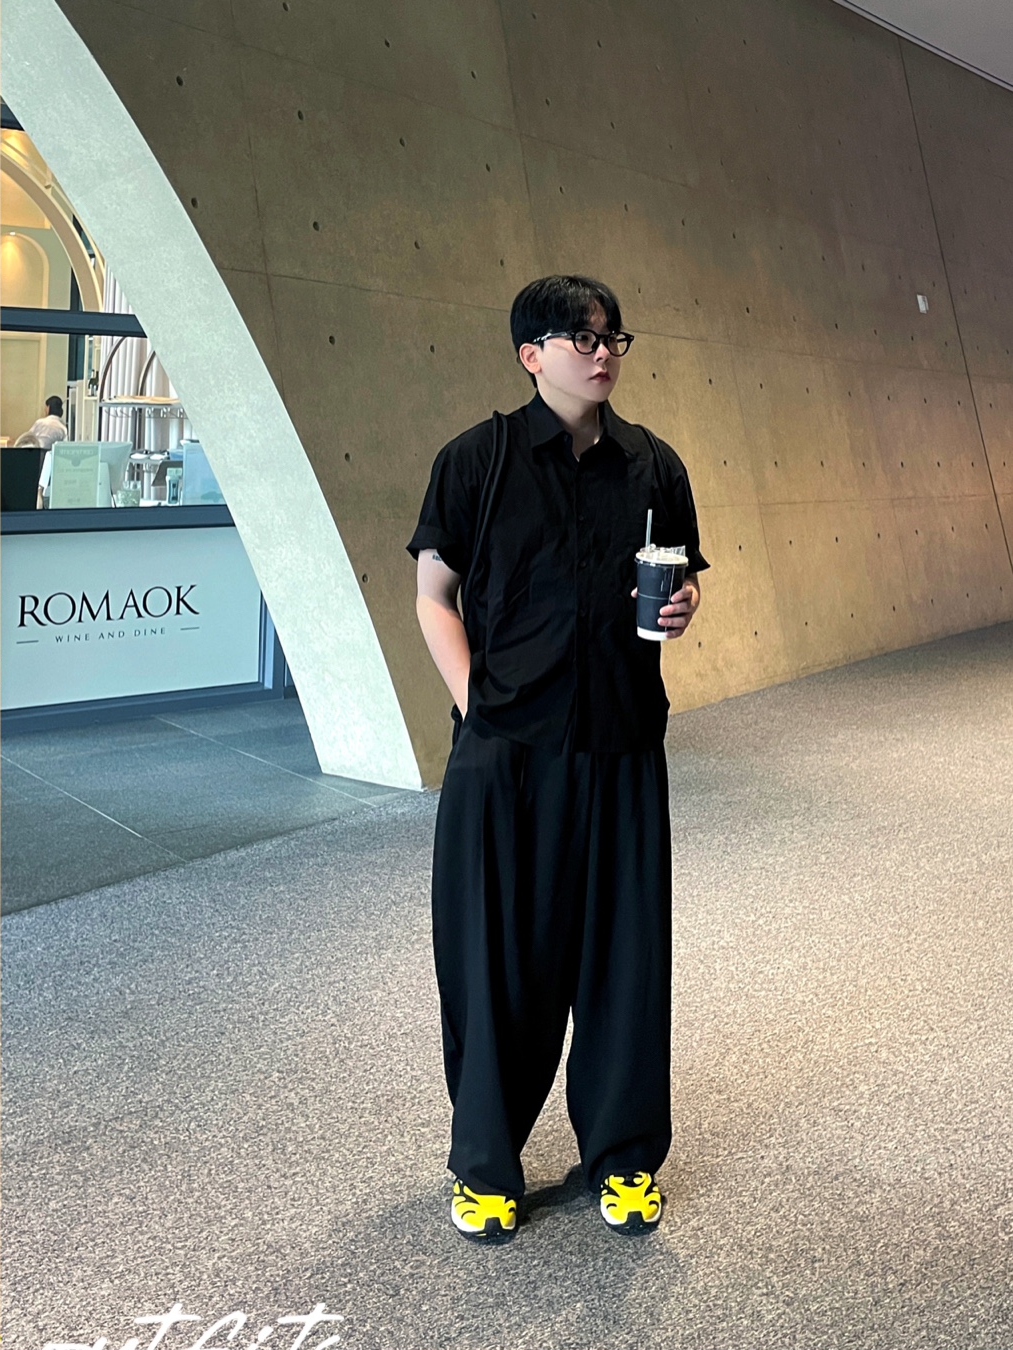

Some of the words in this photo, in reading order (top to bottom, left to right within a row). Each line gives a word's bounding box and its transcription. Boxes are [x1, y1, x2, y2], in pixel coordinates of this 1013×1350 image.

[17, 584, 200, 627] ROMAOK
[55, 633, 90, 643] WINE
[98, 630, 125, 640] AND
[134, 627, 166, 637] DINE
